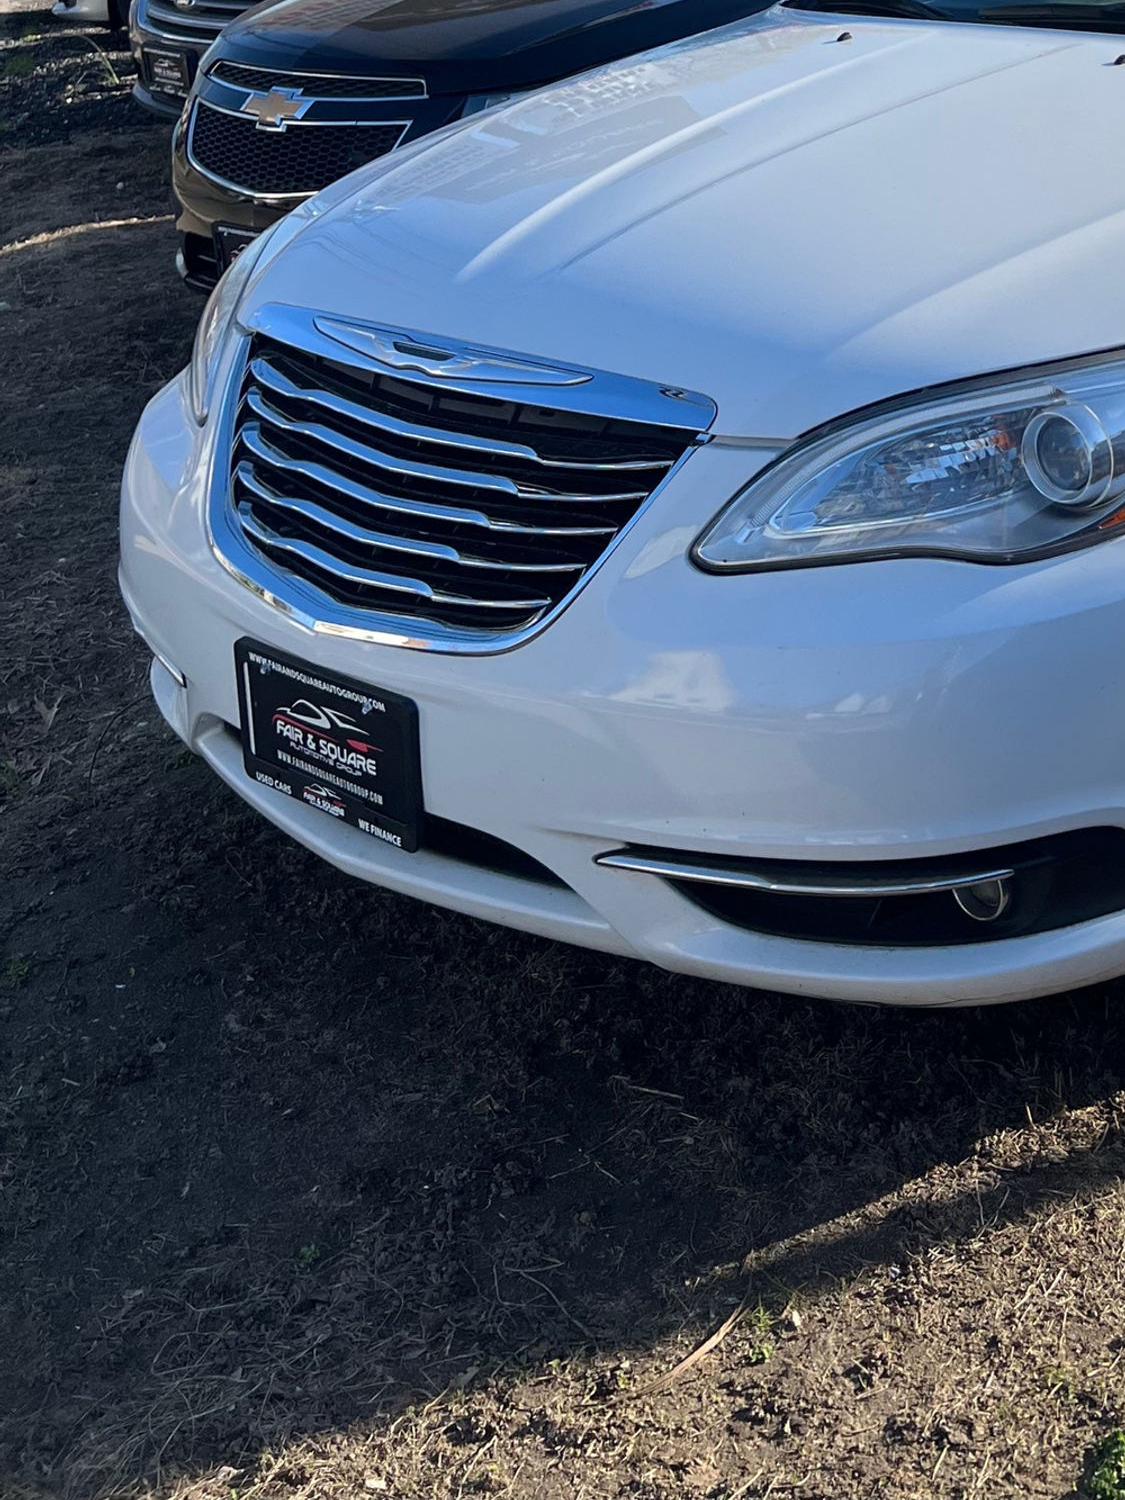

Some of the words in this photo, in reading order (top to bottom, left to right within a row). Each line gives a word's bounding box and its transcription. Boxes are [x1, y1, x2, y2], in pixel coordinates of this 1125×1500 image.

[276, 720, 304, 745] FAIR
[307, 733, 316, 750] &
[319, 739, 377, 776] SQUARE
[256, 771, 274, 786] USED
[275, 780, 292, 795] CARS
[357, 818, 370, 833] WE
[370, 824, 402, 847] FINANCE
